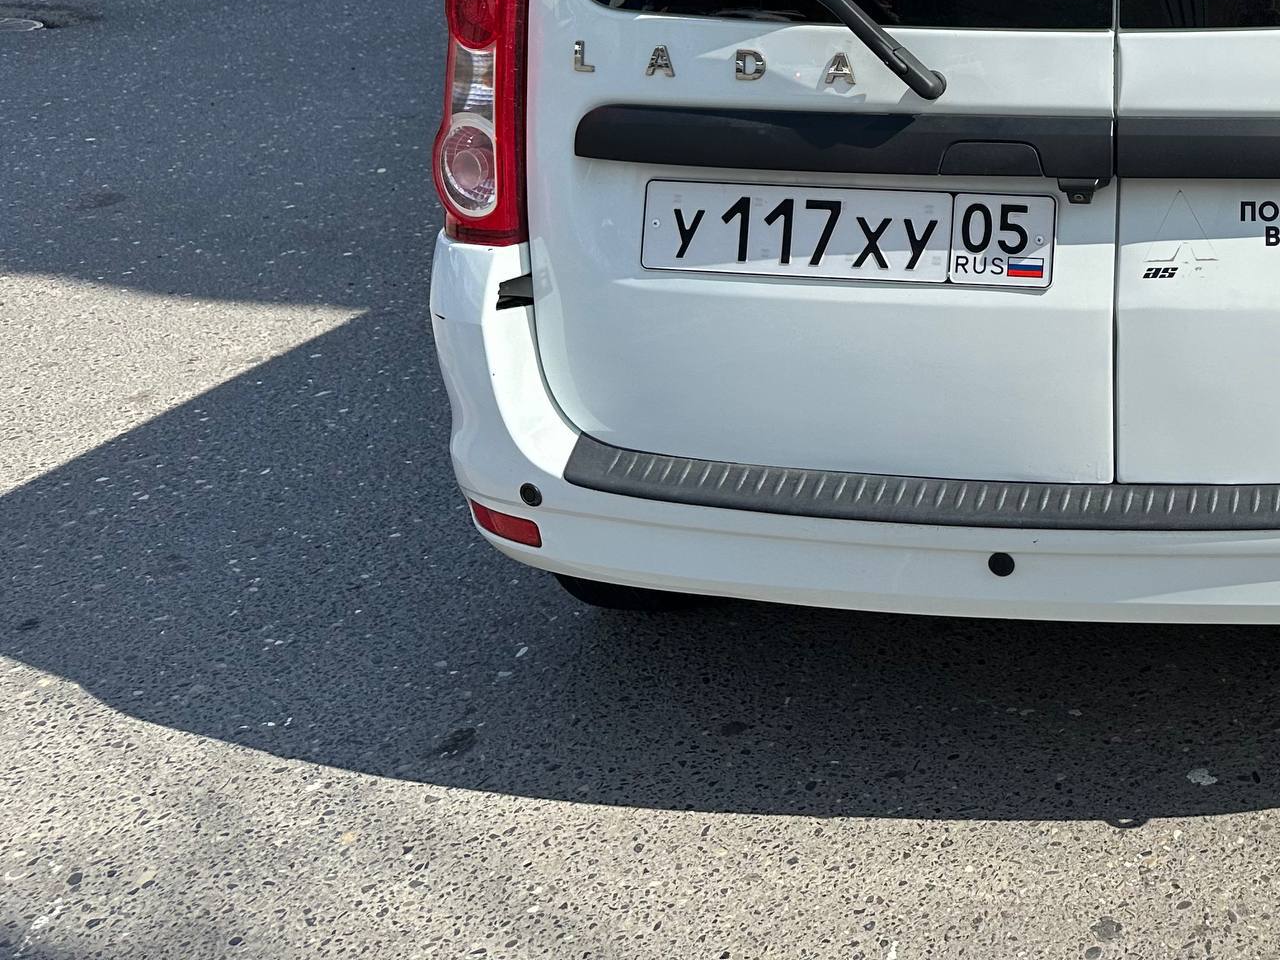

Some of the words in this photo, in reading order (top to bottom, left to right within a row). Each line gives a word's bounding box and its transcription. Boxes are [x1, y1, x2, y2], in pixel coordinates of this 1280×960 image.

[574, 40, 856, 86] LADA
[961, 203, 1030, 255] 05
[955, 255, 1004, 275] RUS
